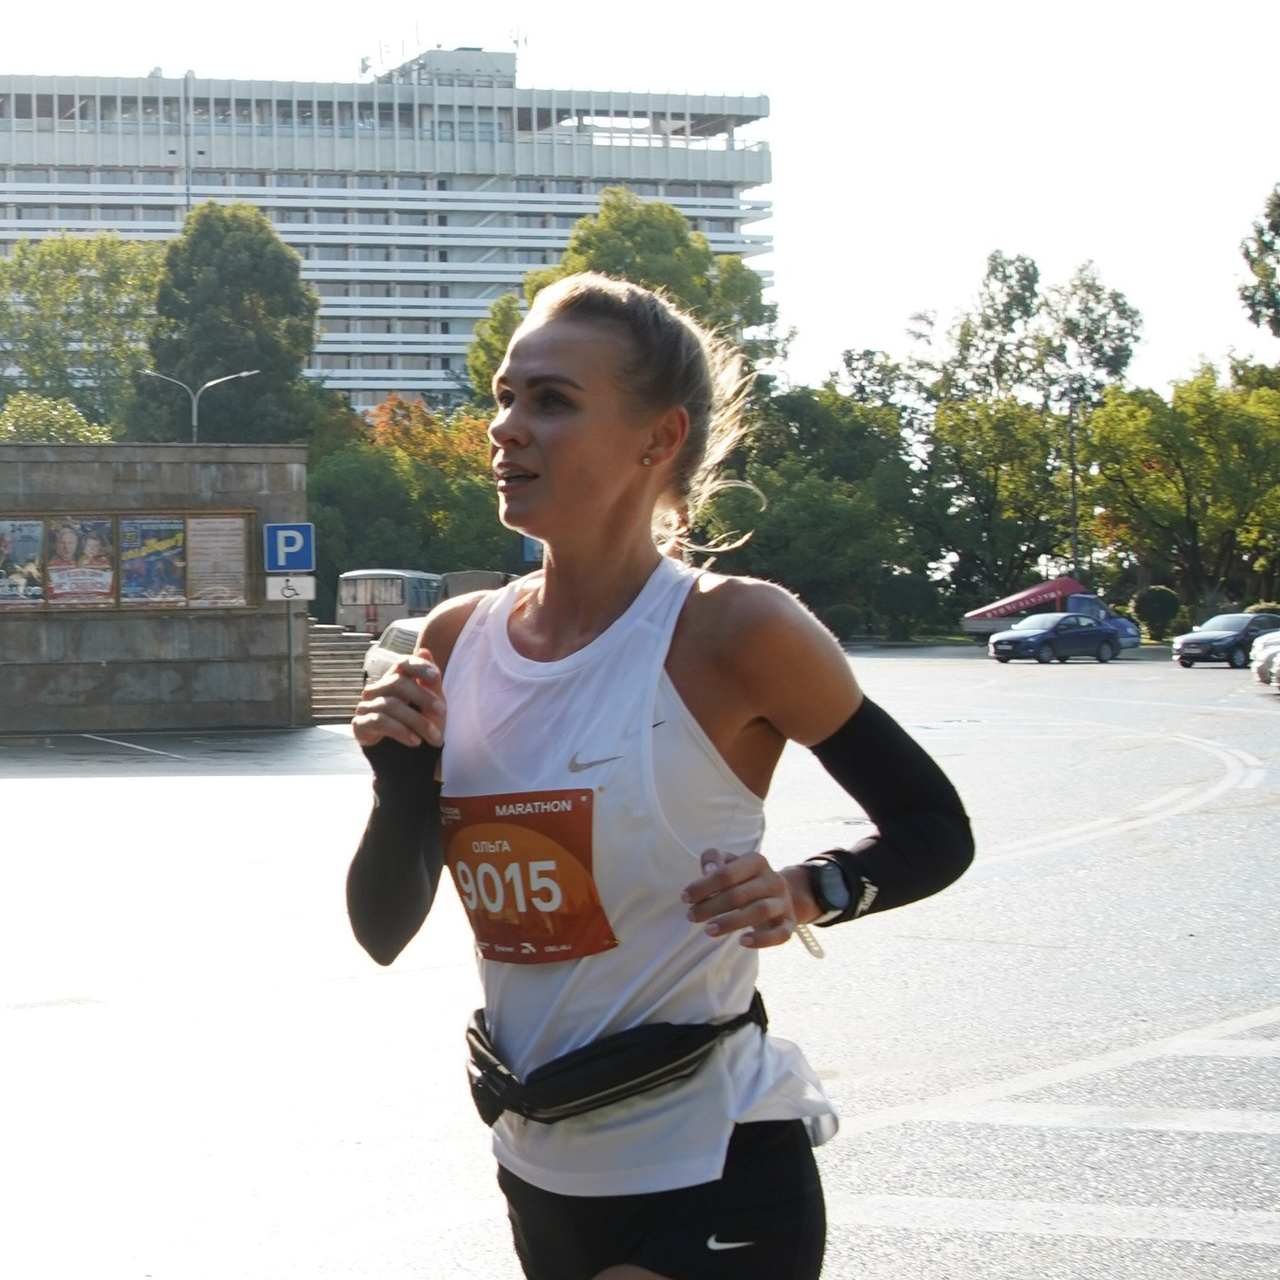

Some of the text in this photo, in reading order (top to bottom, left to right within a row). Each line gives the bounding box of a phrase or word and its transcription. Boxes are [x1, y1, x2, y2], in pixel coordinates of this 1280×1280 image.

[276, 530, 303, 566] P
[495, 800, 572, 816] MARATHON
[471, 840, 511, 855] ОЛЬГА
[456, 859, 563, 914] 9015
